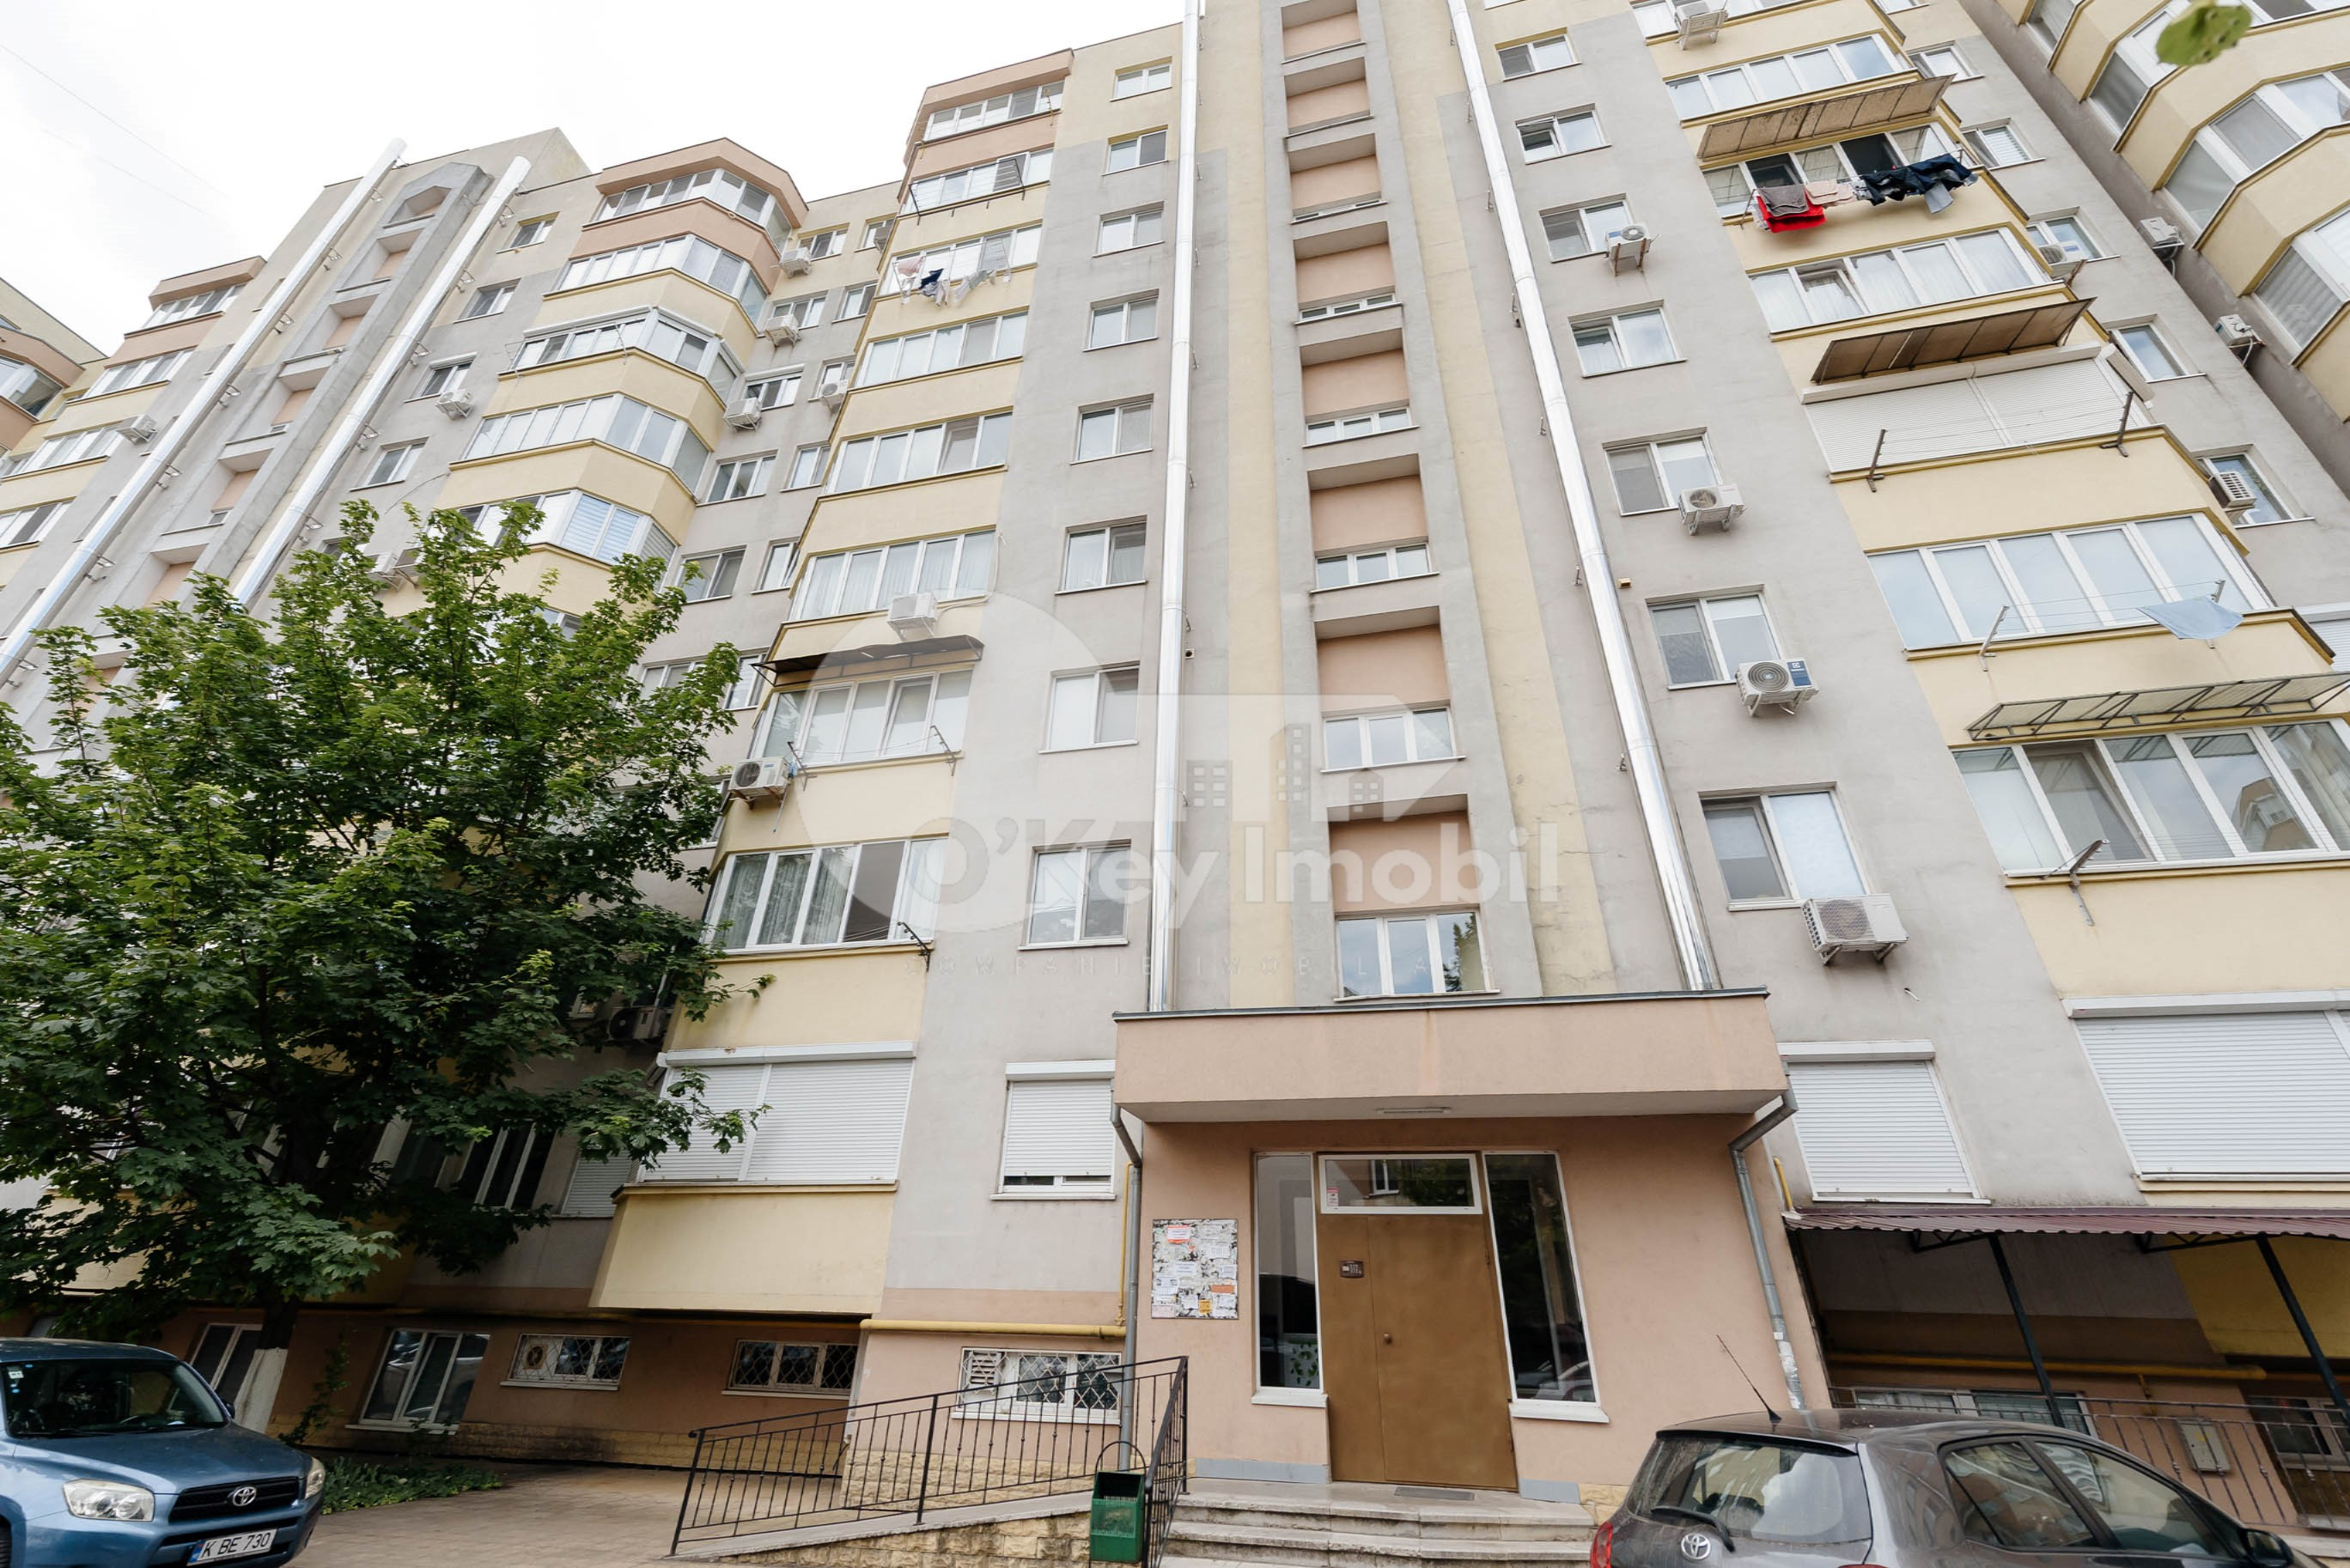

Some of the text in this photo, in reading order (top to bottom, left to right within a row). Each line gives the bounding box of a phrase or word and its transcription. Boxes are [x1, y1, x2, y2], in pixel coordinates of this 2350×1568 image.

[201, 1541, 216, 1559] K
[218, 1537, 242, 1554] BE
[243, 1533, 271, 1551] 730
